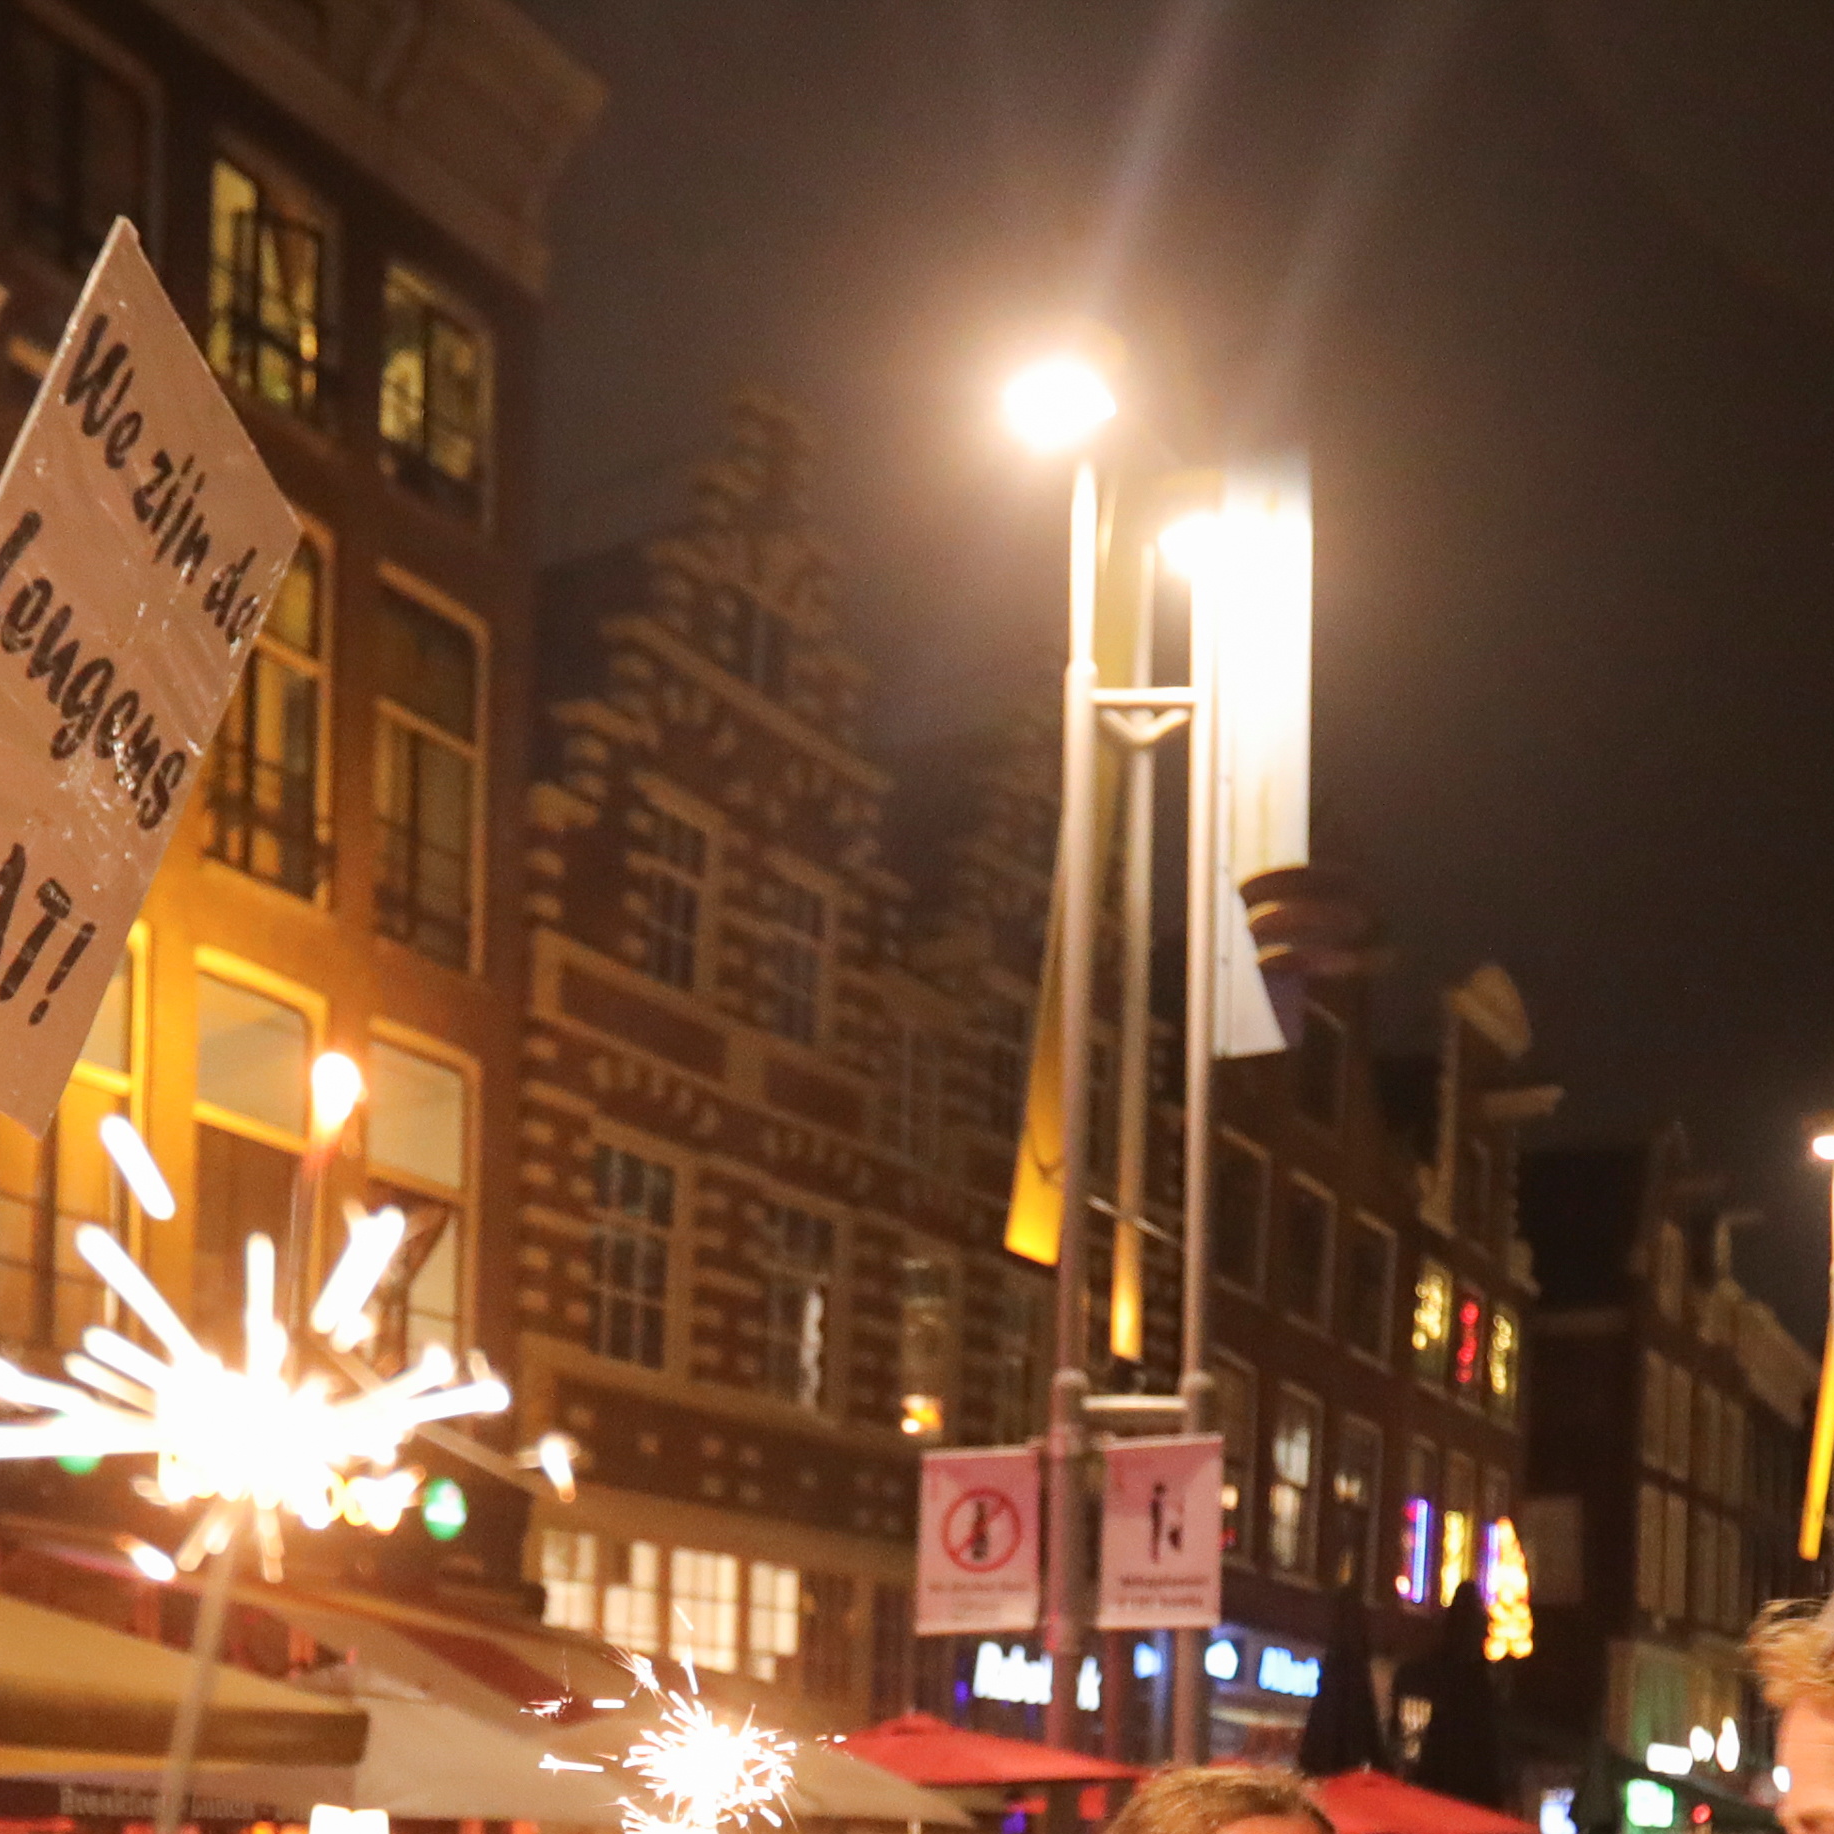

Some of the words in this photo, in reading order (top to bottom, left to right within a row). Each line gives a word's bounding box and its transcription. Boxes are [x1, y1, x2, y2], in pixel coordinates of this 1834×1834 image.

[66, 314, 143, 470] We
[132, 449, 211, 585] zijn
[201, 546, 261, 650] de
